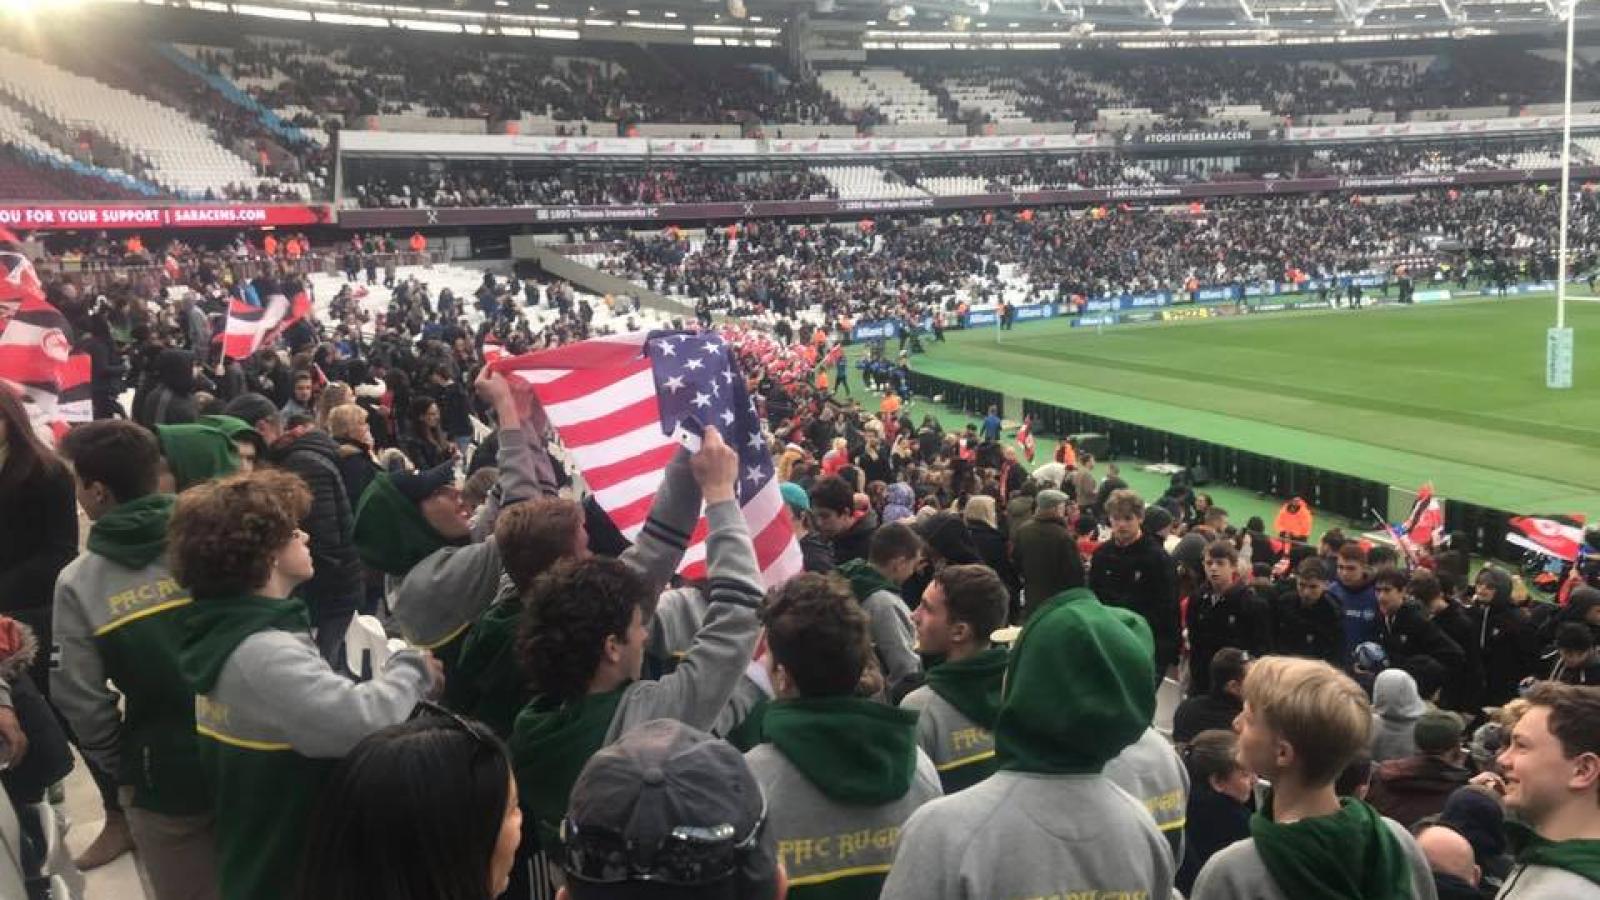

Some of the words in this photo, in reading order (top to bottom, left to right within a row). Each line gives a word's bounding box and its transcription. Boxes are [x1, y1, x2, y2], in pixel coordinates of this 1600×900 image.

[1144, 131, 1251, 143] #TOGETHERSARACENS
[0, 209, 20, 222] OU
[26, 209, 54, 222] FOR
[58, 209, 97, 222] YOUR
[102, 208, 160, 222] SUPPORT
[174, 208, 266, 221] SARACENS.COM
